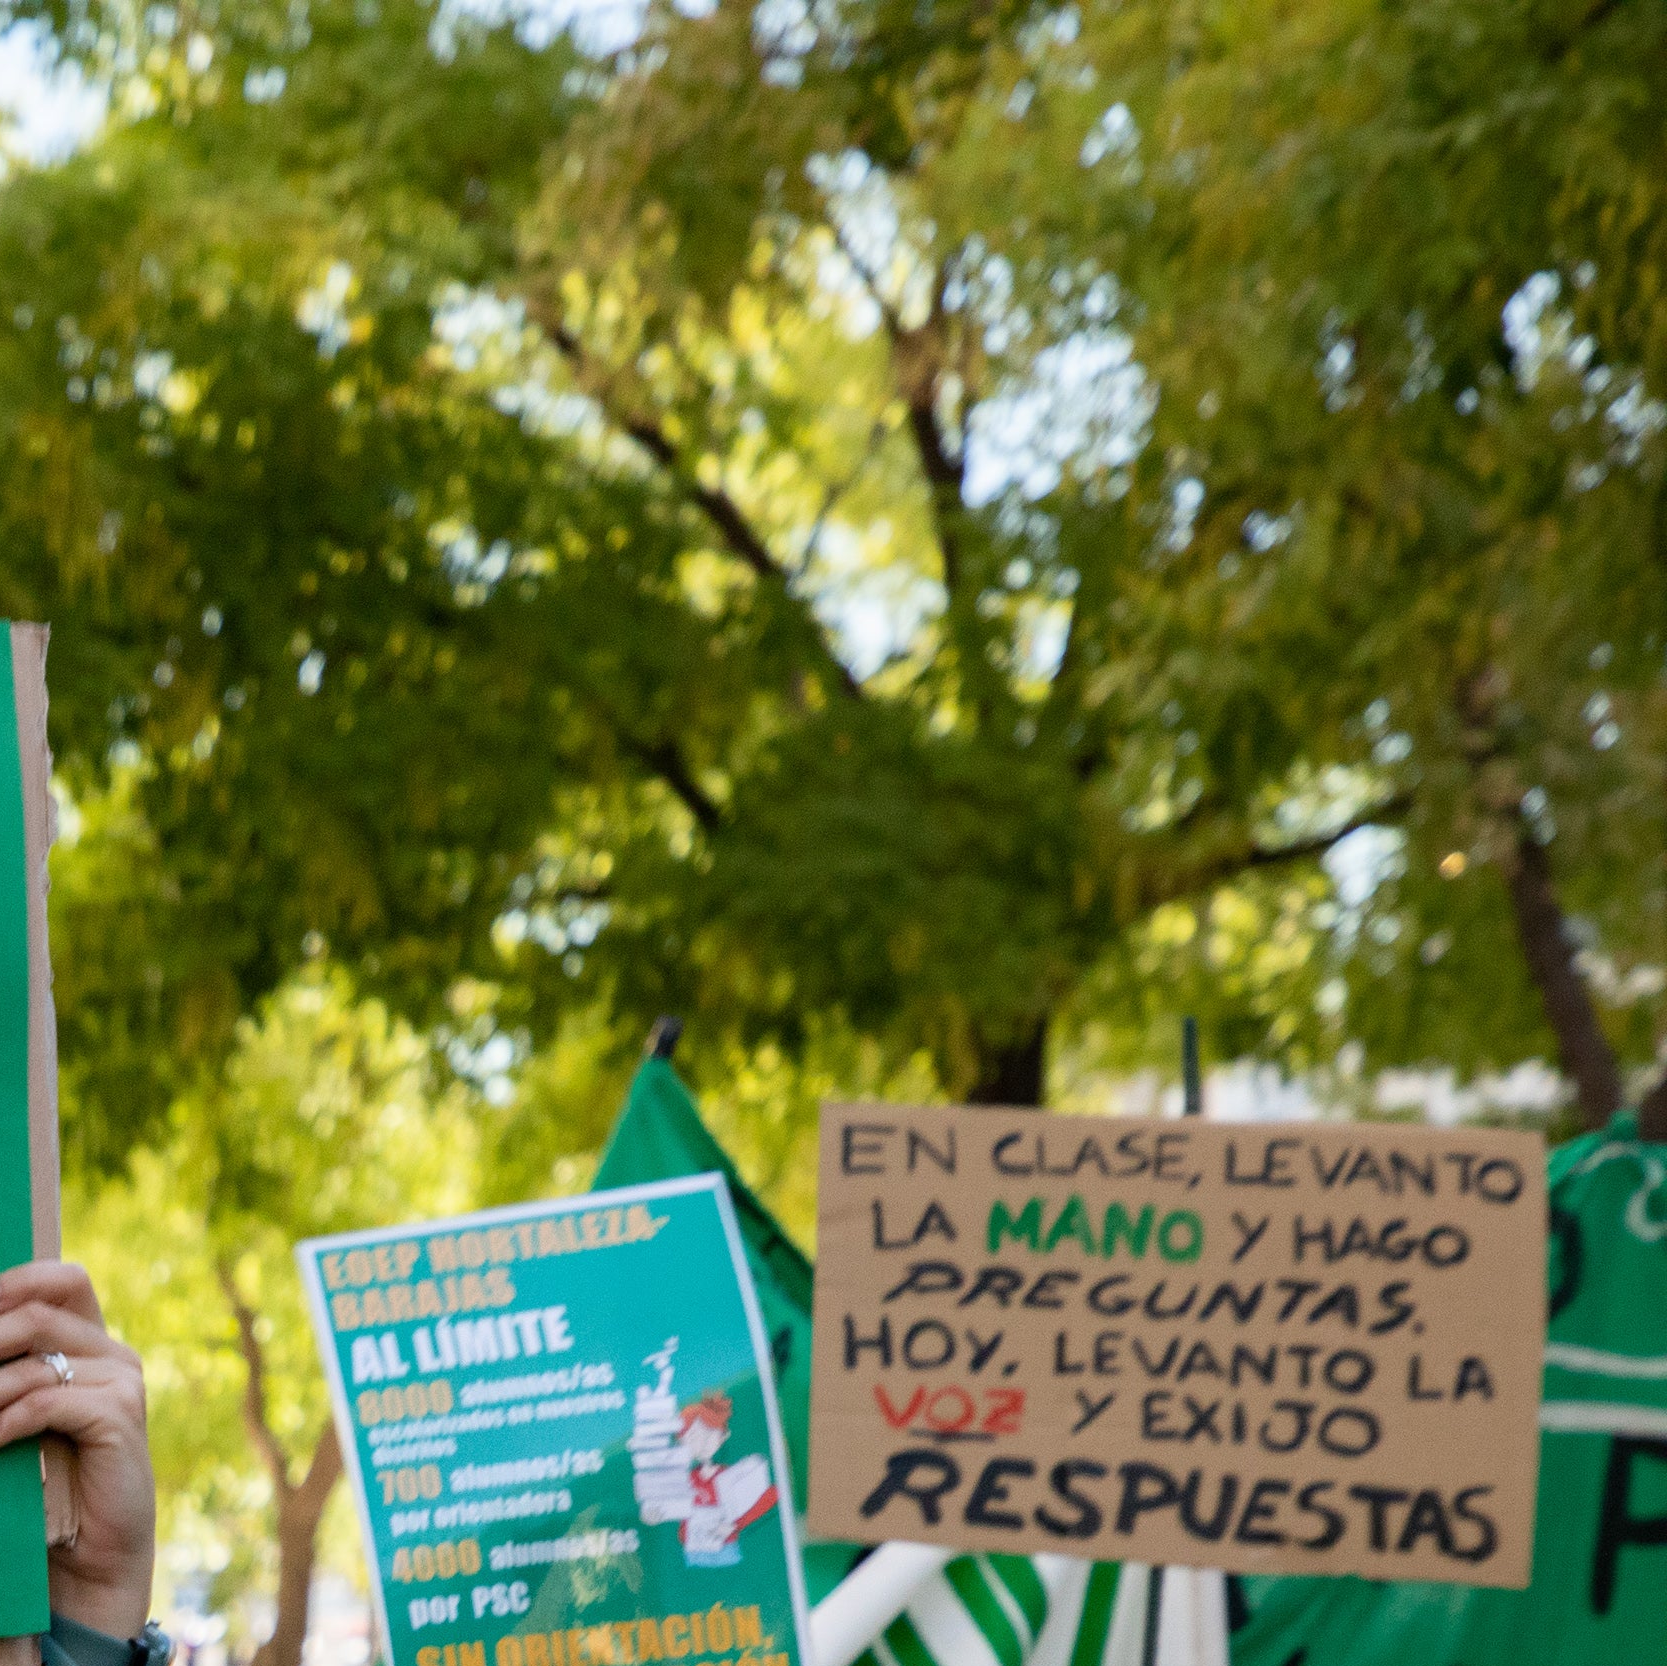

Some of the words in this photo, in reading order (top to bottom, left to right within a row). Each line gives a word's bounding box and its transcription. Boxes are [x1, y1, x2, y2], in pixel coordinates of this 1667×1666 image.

[841, 1126, 957, 1175] EN
[991, 1132, 1202, 1191] CLASE,
[1224, 1137, 1524, 1204] LEVANTO
[872, 1200, 956, 1251] LA
[986, 1194, 1204, 1264] MANO
[1232, 1212, 1269, 1264] Y
[1292, 1214, 1469, 1267] HAGO
[332, 1268, 516, 1332] BARAJAS
[351, 1332, 410, 1385] AL
[413, 1304, 575, 1374] LÍMITE
[844, 1314, 1023, 1376] HOY,
[1054, 1331, 1374, 1394] LEVANTO
[1408, 1354, 1495, 1402] LA
[875, 1383, 1027, 1433] VOZ
[1073, 1391, 1114, 1434] Y
[1142, 1390, 1381, 1456] EXIJO
[376, 1464, 443, 1506] 700
[390, 1509, 430, 1537] por
[433, 1489, 573, 1529] orientadora
[860, 1448, 1498, 1562] RESPUESTAS
[391, 1538, 482, 1584] 4000
[409, 1594, 460, 1631] por
[471, 1580, 531, 1619] PSC
